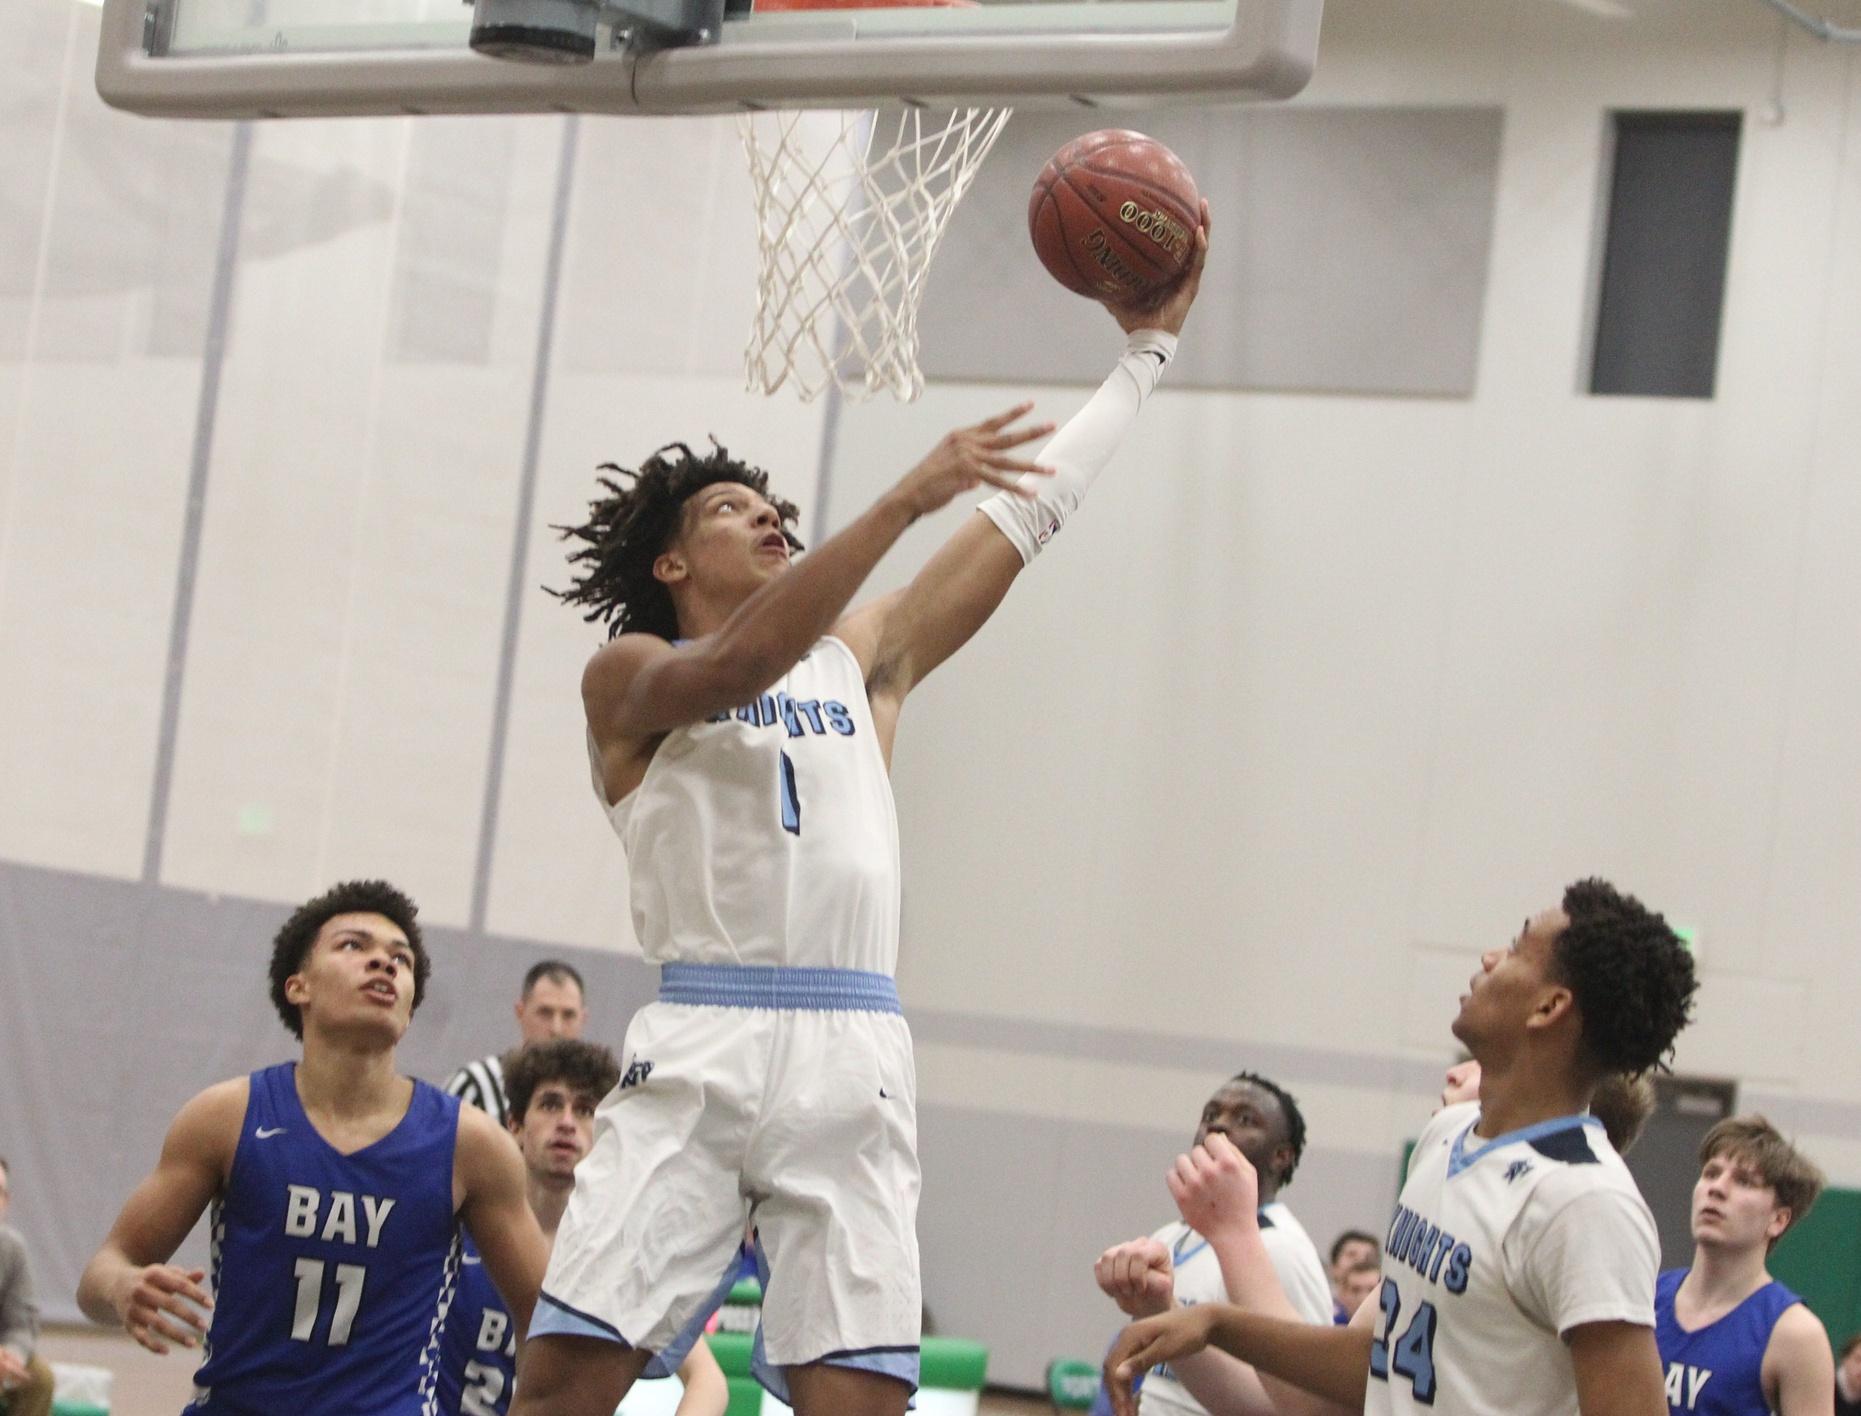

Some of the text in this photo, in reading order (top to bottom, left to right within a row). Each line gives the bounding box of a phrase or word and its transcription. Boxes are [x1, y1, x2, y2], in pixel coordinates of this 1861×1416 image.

[285, 1184, 396, 1248] BAY
[290, 1257, 366, 1346] 11
[1370, 1276, 1437, 1407] 24
[460, 1359, 517, 1416] 2
[1664, 1361, 1712, 1410] AY
